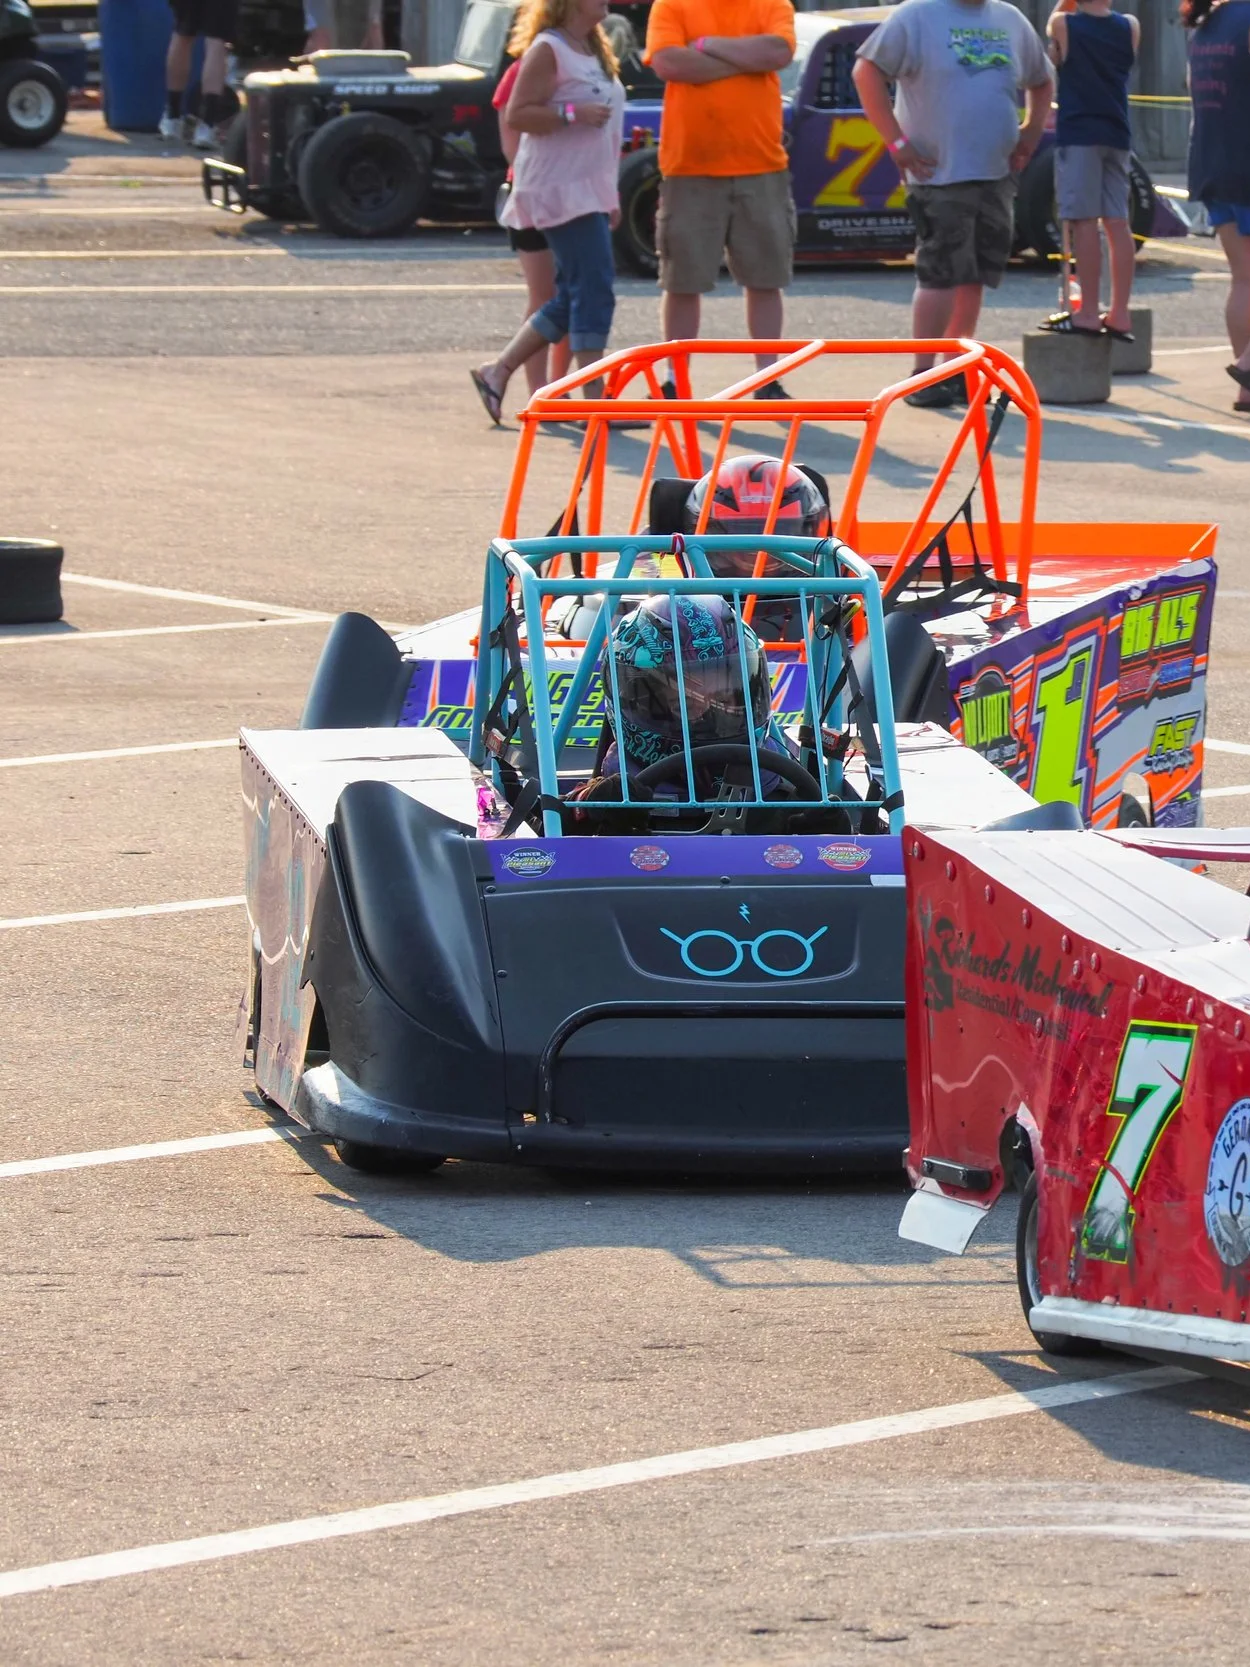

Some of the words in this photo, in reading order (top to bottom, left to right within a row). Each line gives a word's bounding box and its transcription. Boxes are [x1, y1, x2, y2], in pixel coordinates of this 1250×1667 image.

[1121, 604, 1157, 657] BIG
[1149, 714, 1198, 757] FAST
[935, 917, 1012, 984] Richards
[1081, 1019, 1198, 1264] 7
